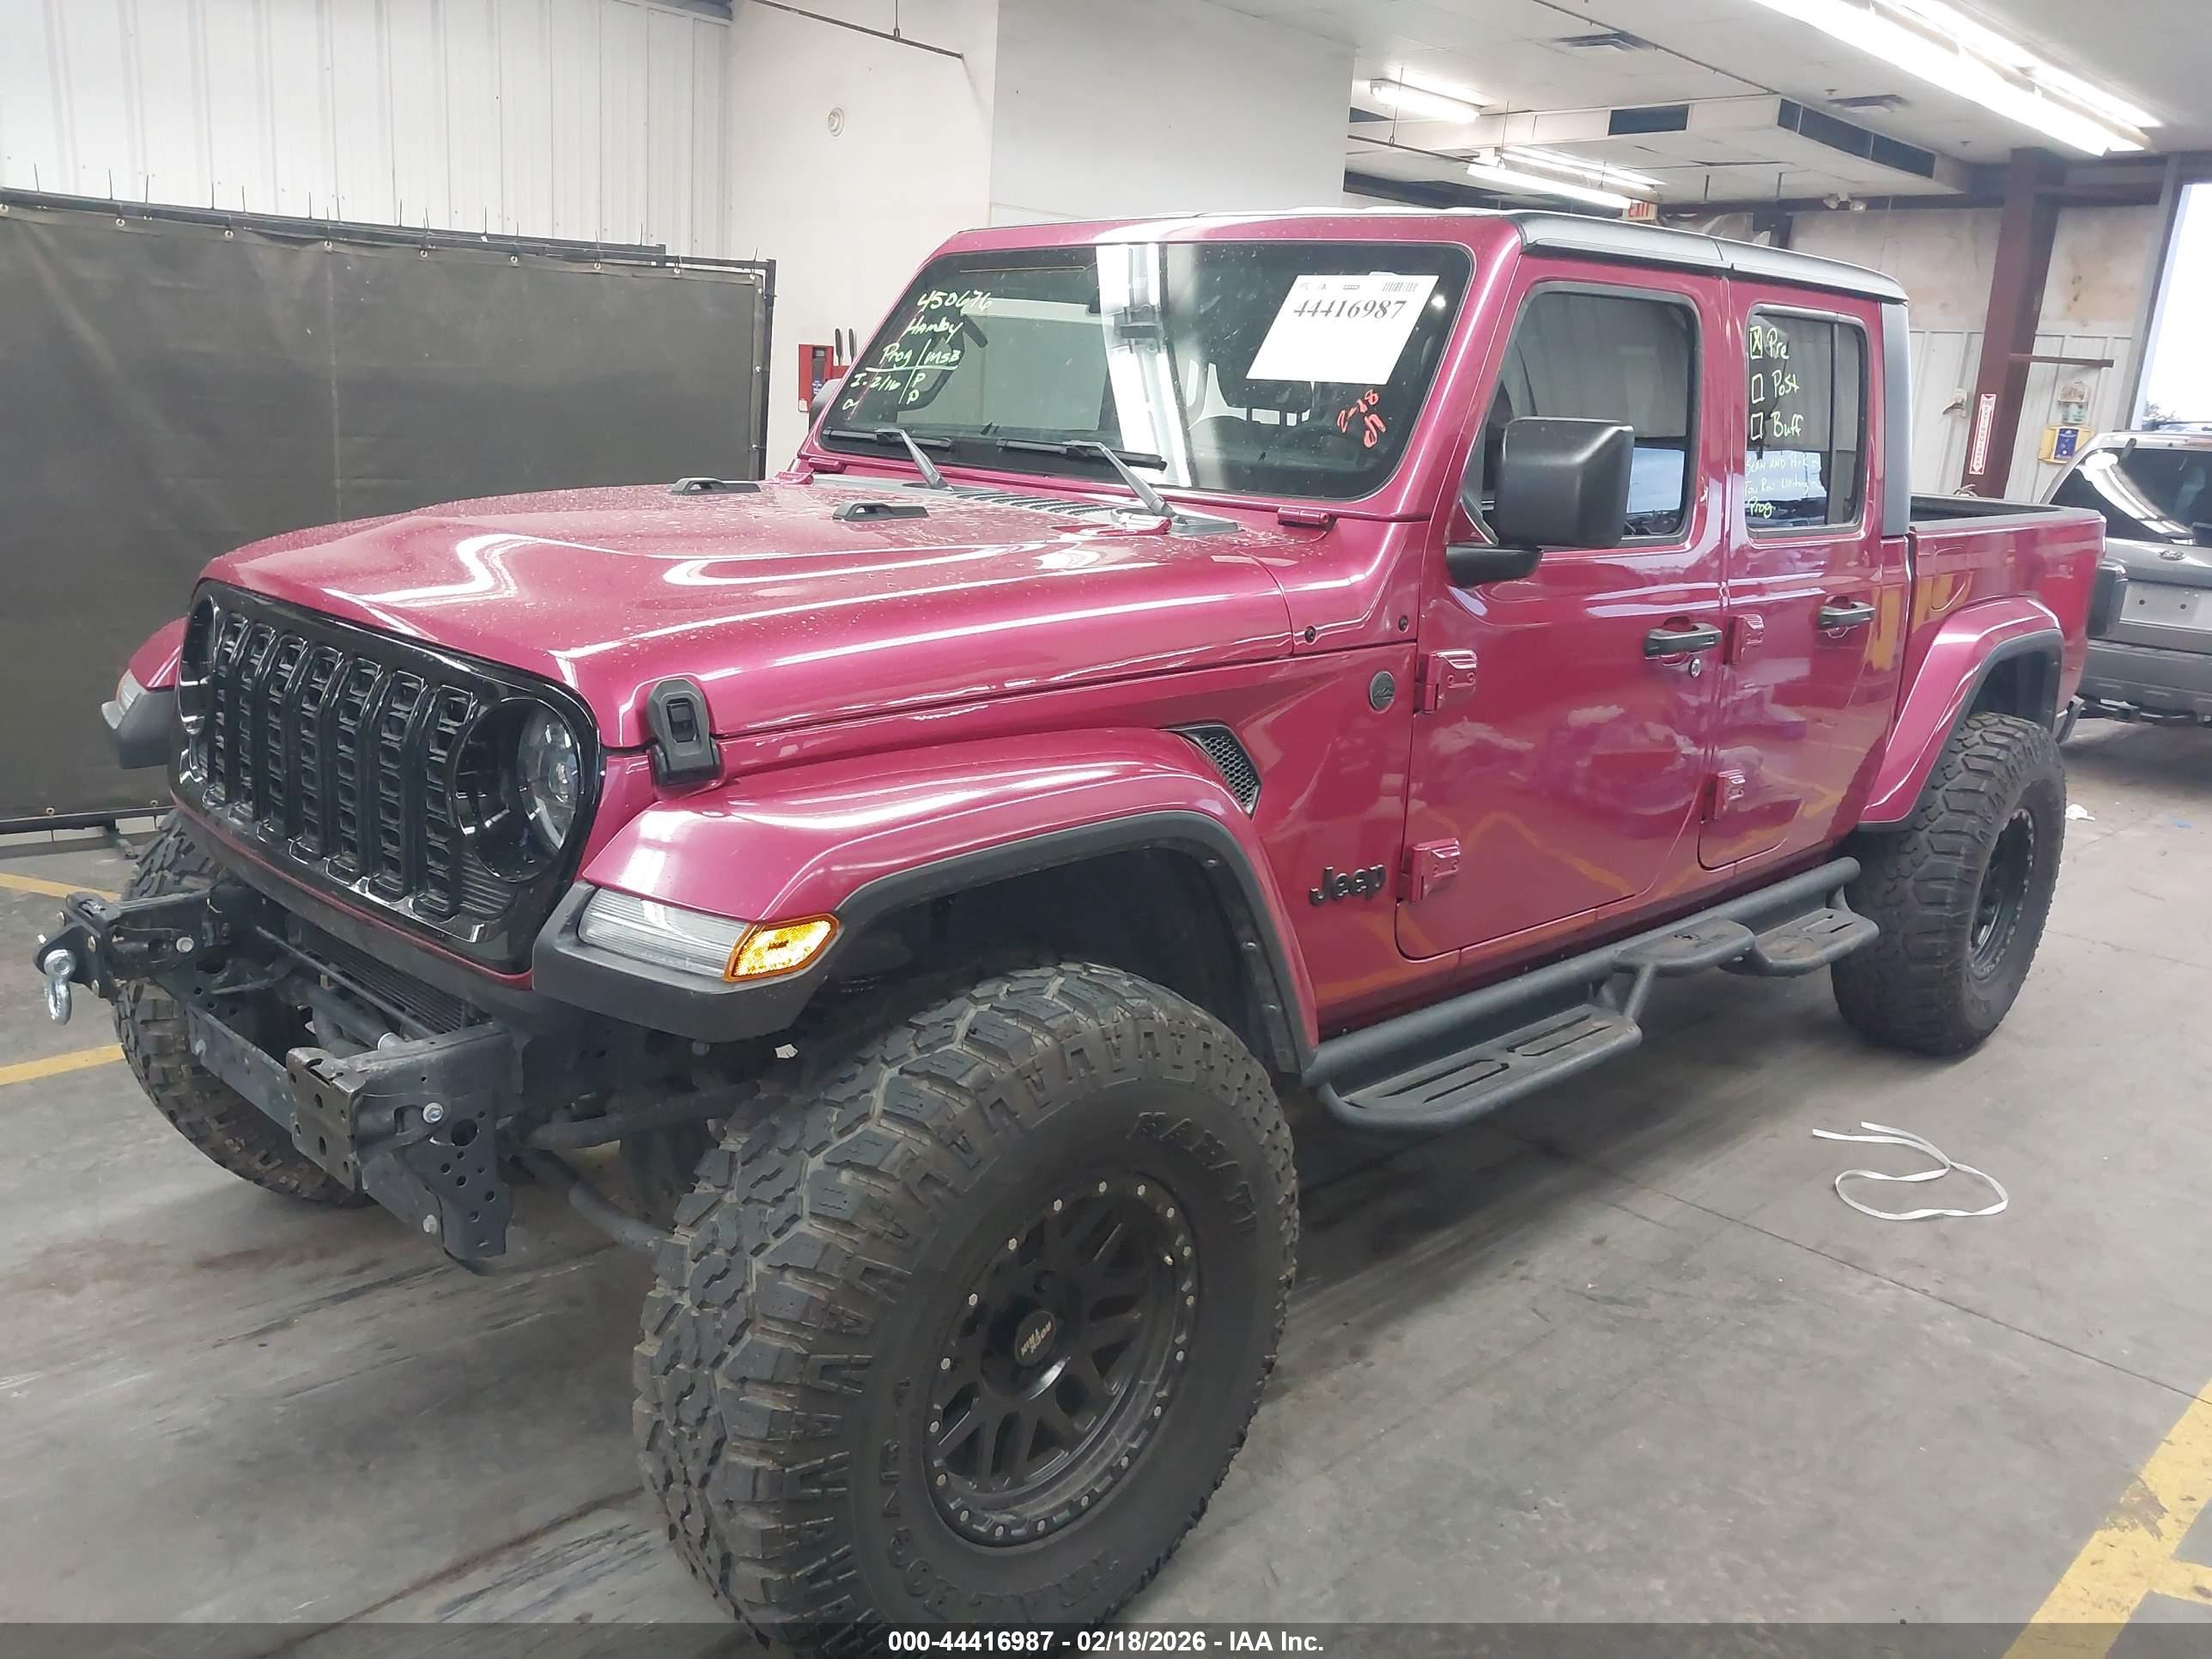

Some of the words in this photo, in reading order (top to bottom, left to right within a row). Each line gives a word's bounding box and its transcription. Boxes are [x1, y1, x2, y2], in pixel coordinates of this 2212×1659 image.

[917, 289, 993, 312] 450676
[1293, 299, 1408, 319] 44416987
[879, 342, 913, 369] Prog
[1766, 327, 1790, 359] Pre
[1771, 369, 1800, 398] Post
[1771, 411, 1803, 438] Buff
[1745, 496, 1772, 519] Prog
[1309, 864, 1387, 906] Jeep
